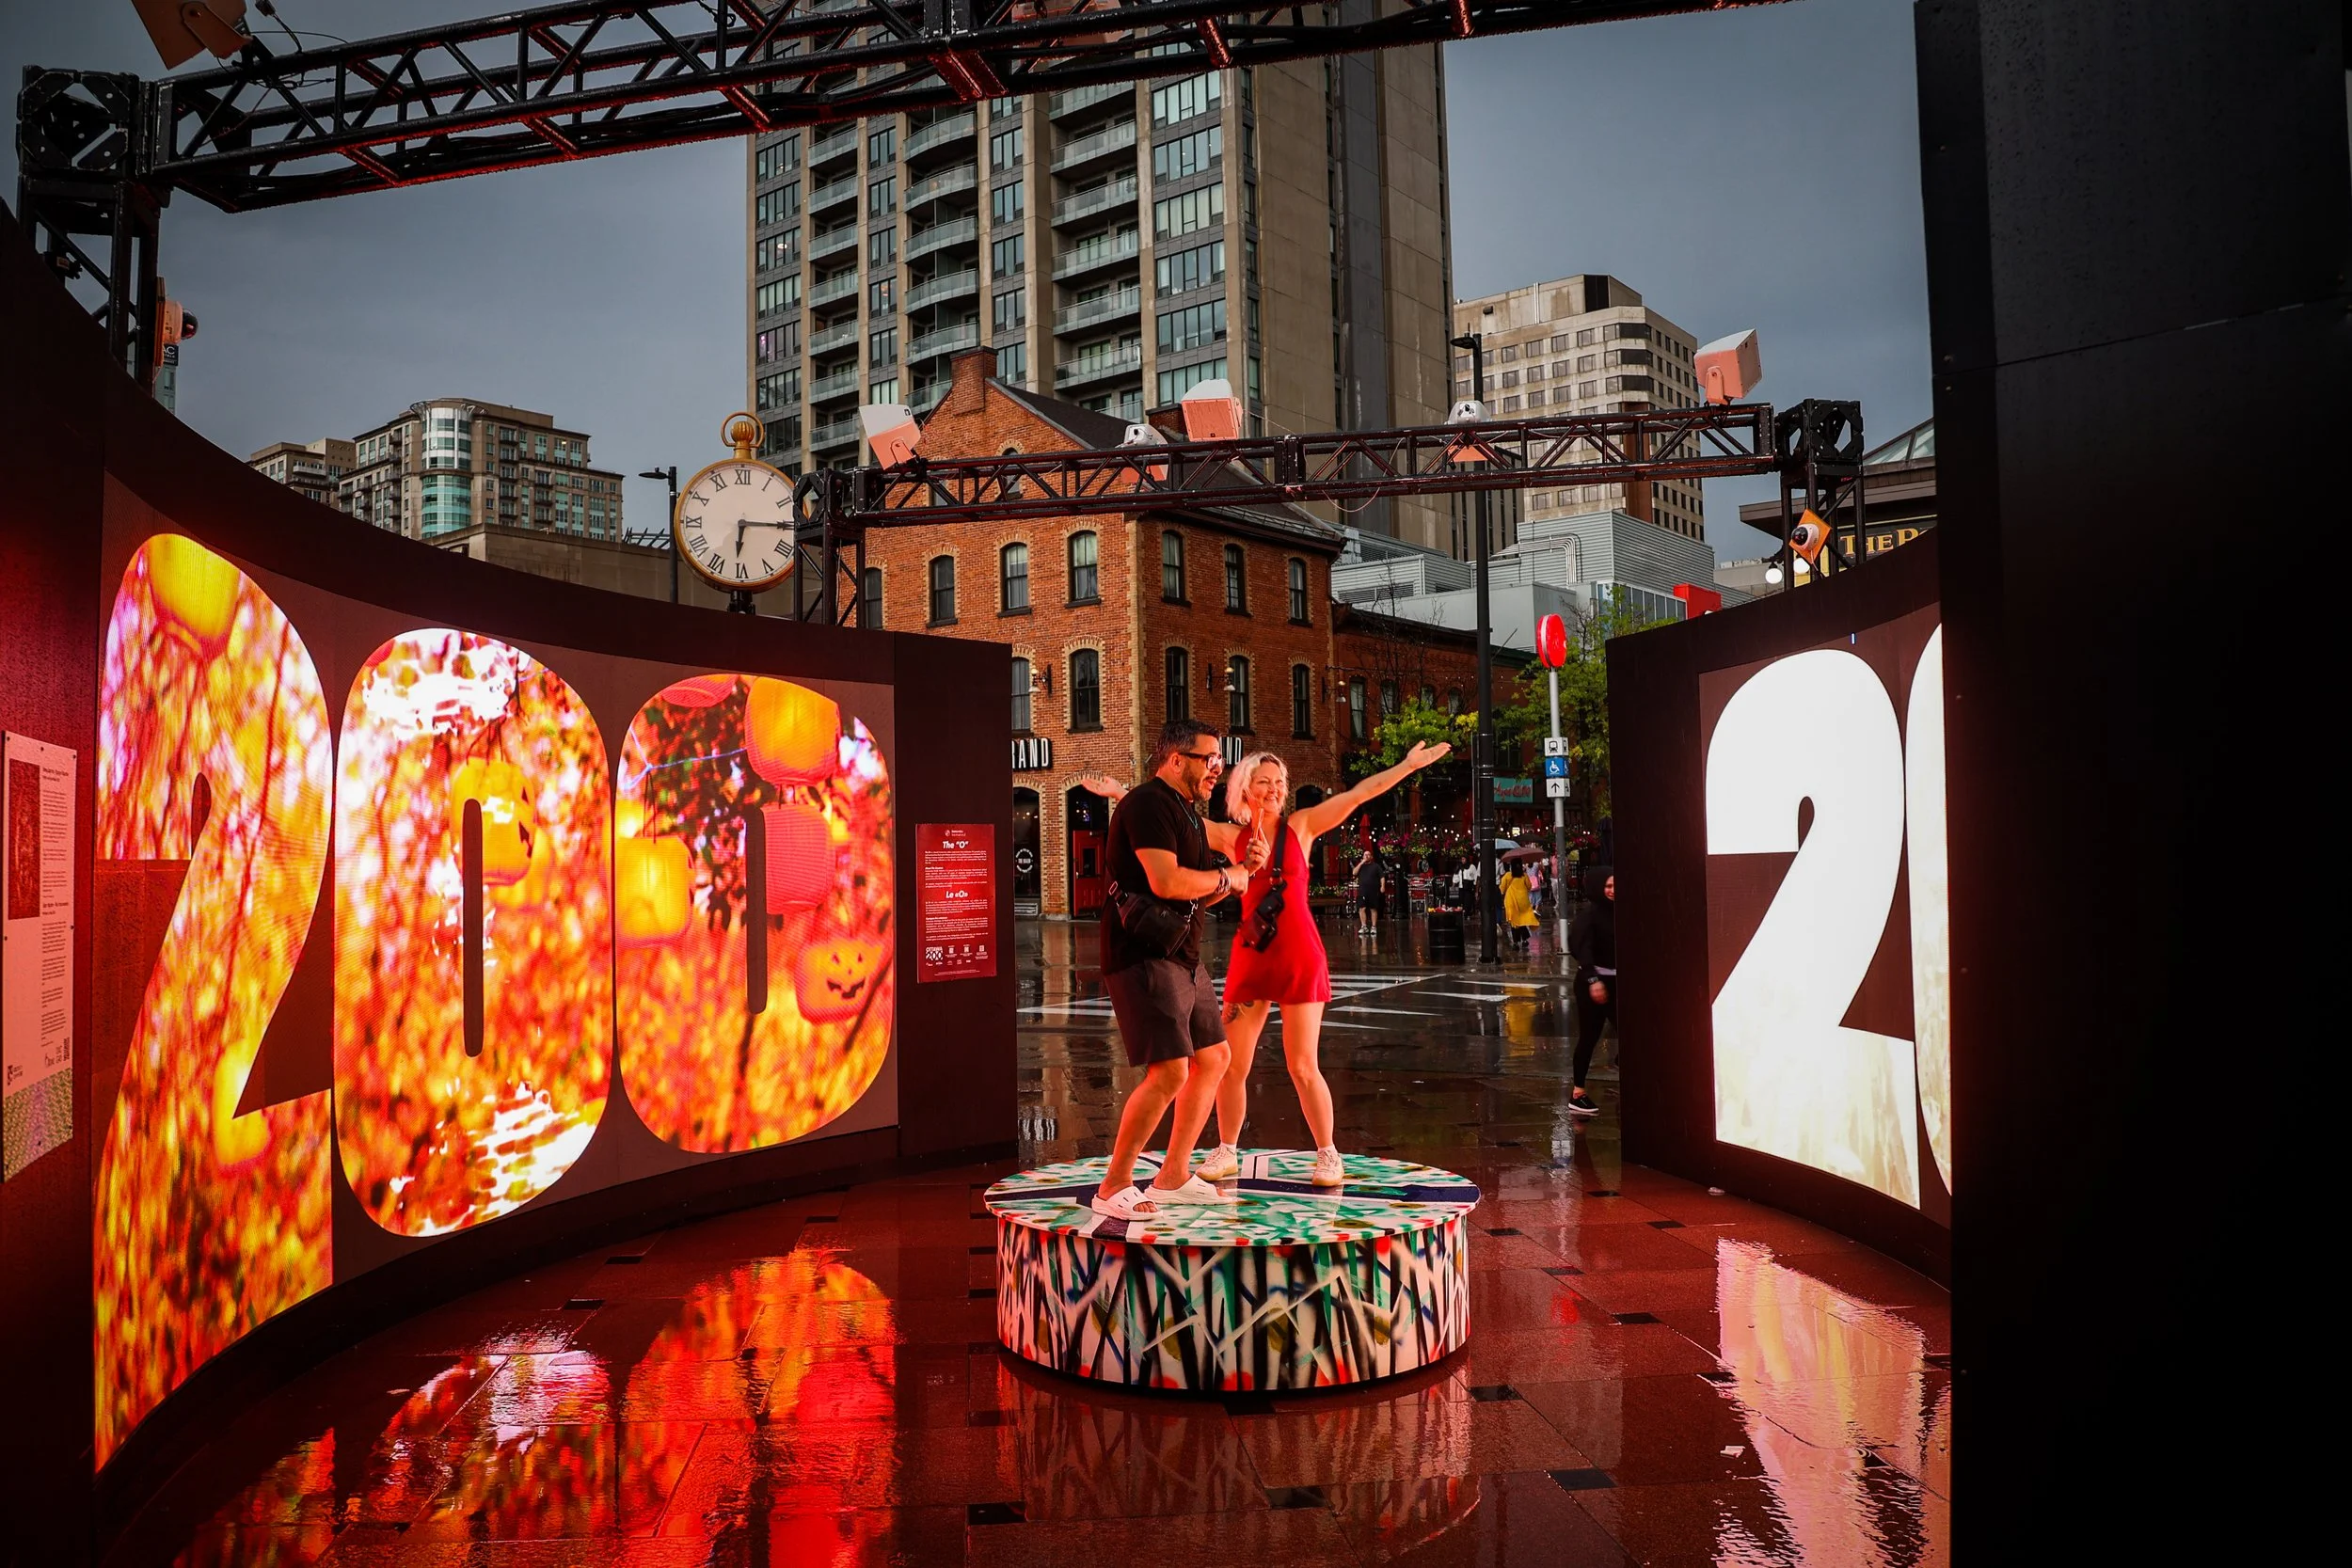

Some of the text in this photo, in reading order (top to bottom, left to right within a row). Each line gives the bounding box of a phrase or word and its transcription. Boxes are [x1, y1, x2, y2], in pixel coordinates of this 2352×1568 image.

[709, 473, 728, 492] XI
[734, 468, 752, 485] XII
[761, 477, 772, 492] I
[691, 491, 709, 507] X
[775, 496, 792, 509] II
[686, 515, 702, 529] IX
[1896, 528, 1921, 546] P
[689, 534, 709, 558] VIII
[774, 539, 794, 559] IIII
[707, 553, 725, 574] VII
[735, 562, 749, 579] VI
[762, 558, 774, 574] V
[943, 839, 954, 848] The
[1706, 625, 1952, 1210] 2
[92, 532, 895, 1474] 200
